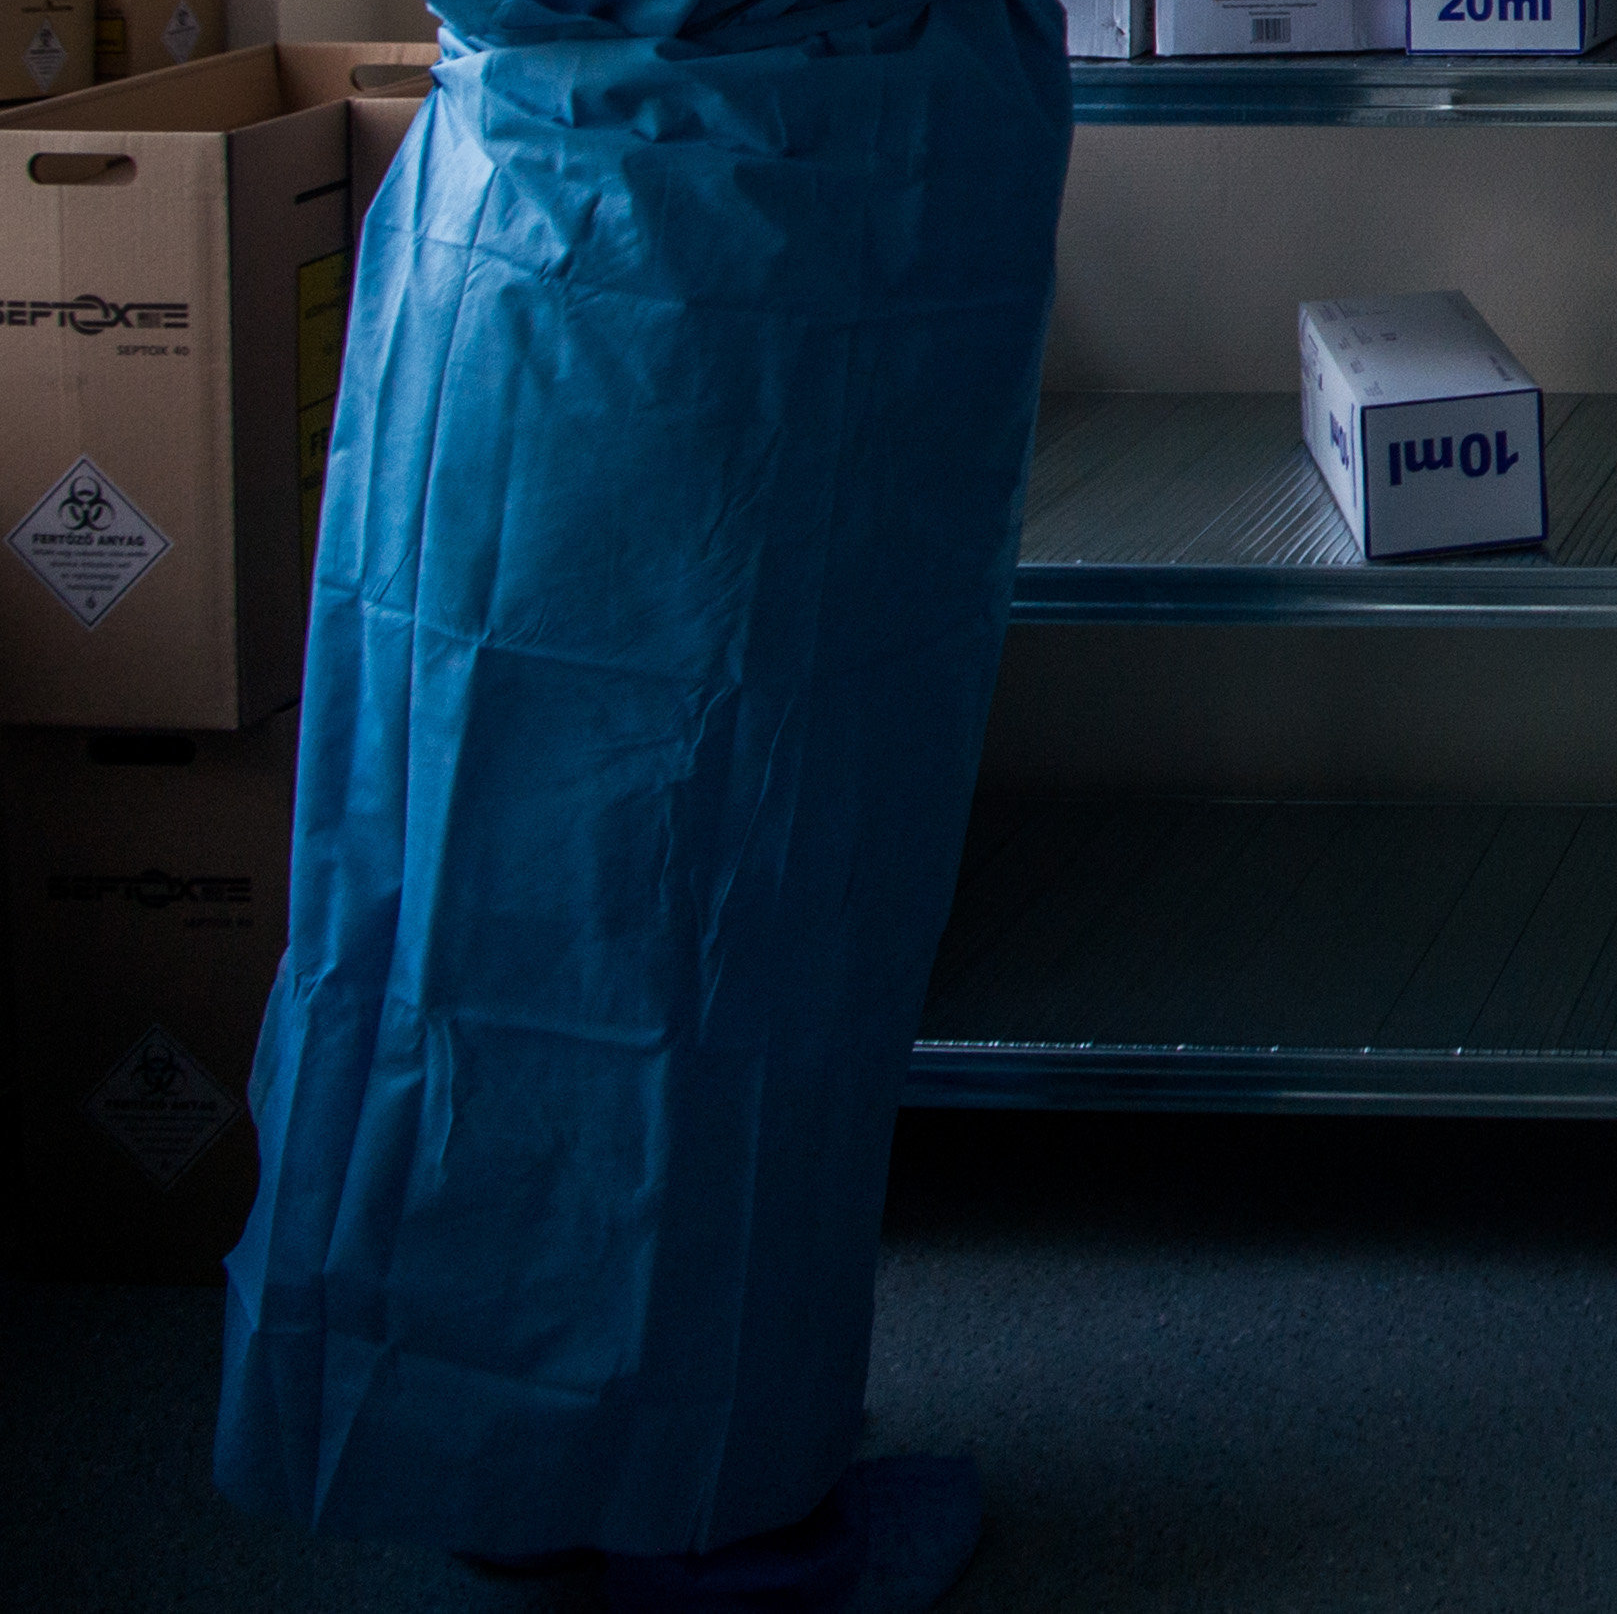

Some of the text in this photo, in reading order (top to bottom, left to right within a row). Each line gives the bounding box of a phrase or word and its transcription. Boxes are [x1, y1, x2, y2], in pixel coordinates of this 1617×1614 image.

[116, 345, 190, 356] SEPTOX 40
[1389, 431, 1520, 486] 10ml
